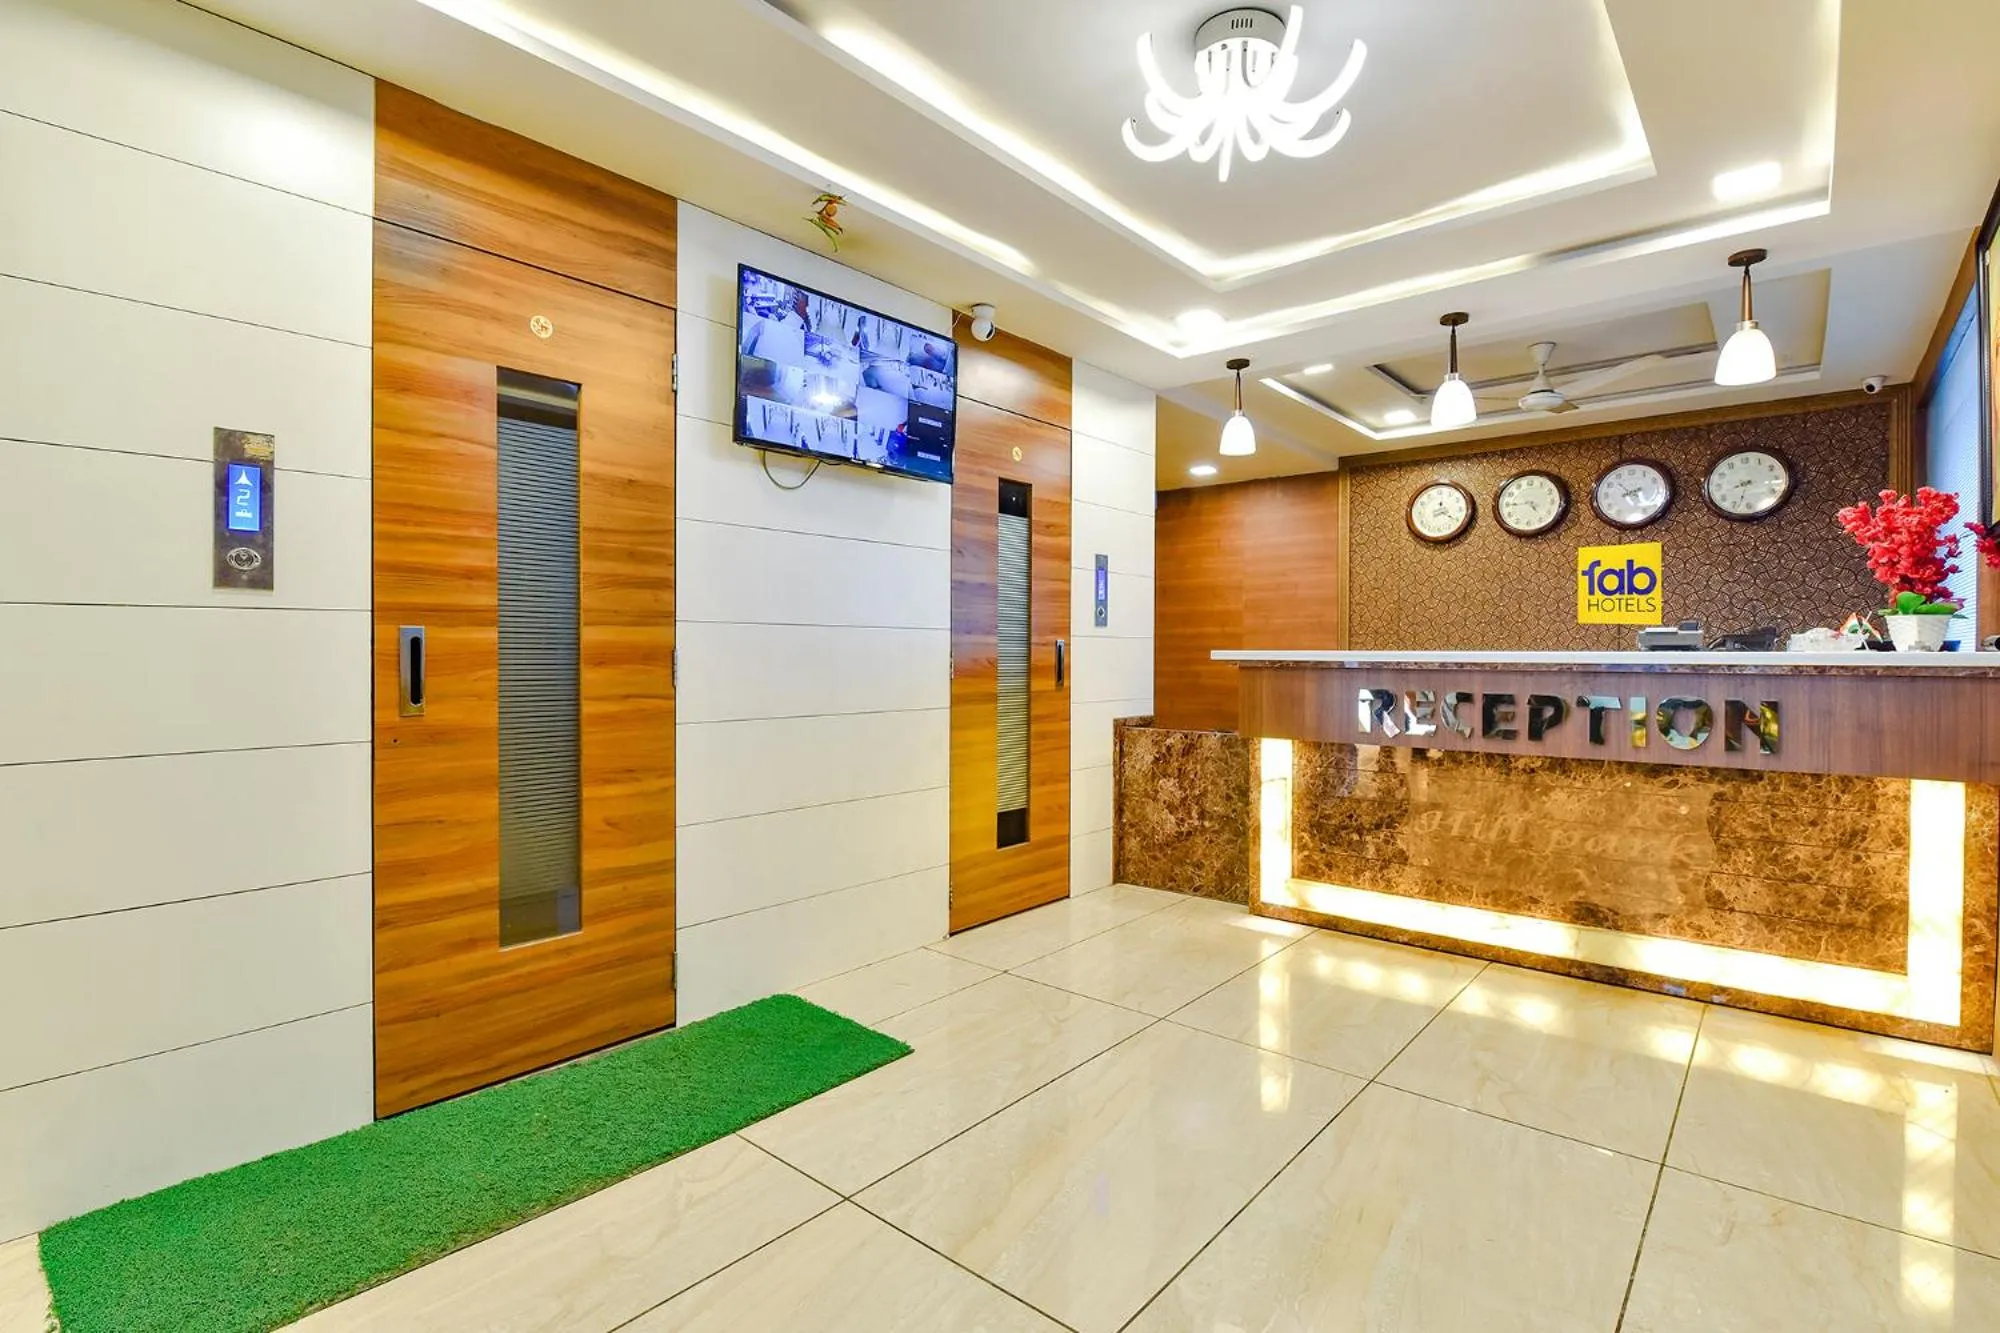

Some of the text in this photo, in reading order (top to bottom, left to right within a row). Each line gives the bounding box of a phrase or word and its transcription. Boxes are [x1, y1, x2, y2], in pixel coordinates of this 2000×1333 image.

[1581, 559, 1657, 596] fab
[1587, 597, 1657, 613] HOTELS
[1357, 688, 1779, 755] RECEPTION
